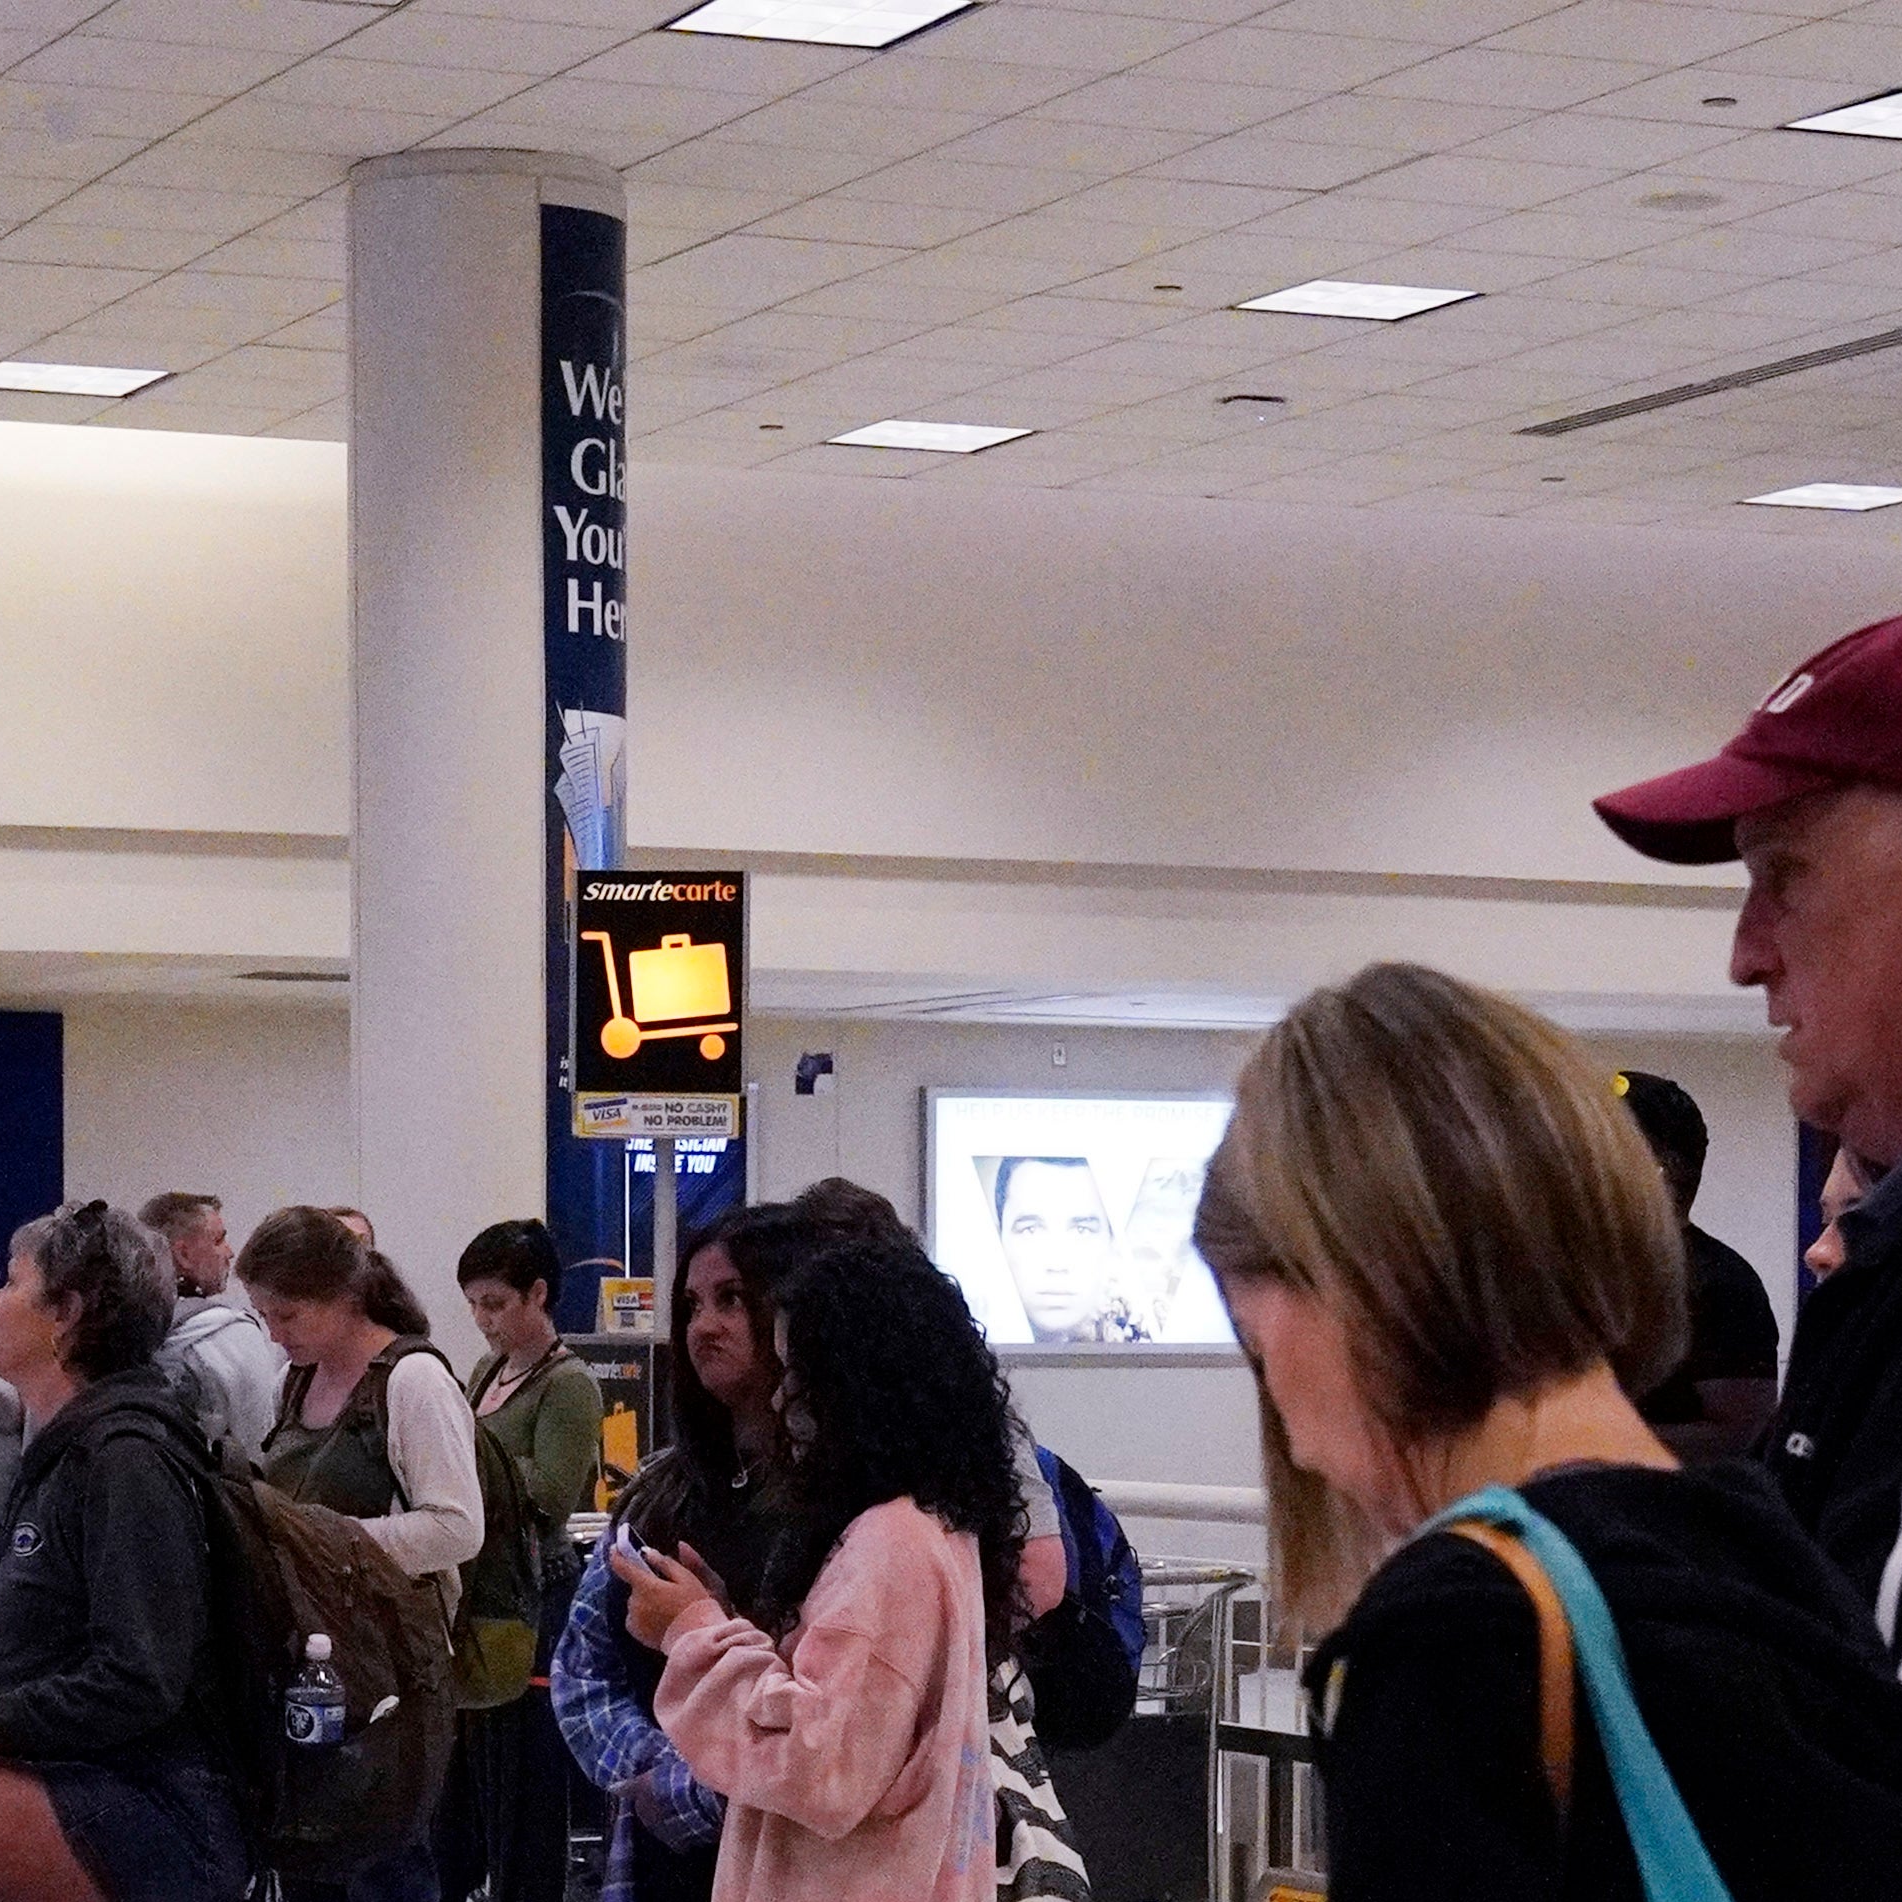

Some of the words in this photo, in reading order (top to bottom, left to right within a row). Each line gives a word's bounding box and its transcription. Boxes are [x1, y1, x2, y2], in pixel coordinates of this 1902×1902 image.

[582, 879, 737, 902] smartecarte
[592, 1107, 622, 1122] VISA
[664, 1102, 684, 1113] NO
[686, 1103, 728, 1114] CASH?
[643, 1115, 663, 1126] NO
[666, 1115, 728, 1127] PROBLEM!
[686, 1154, 717, 1174] YOU
